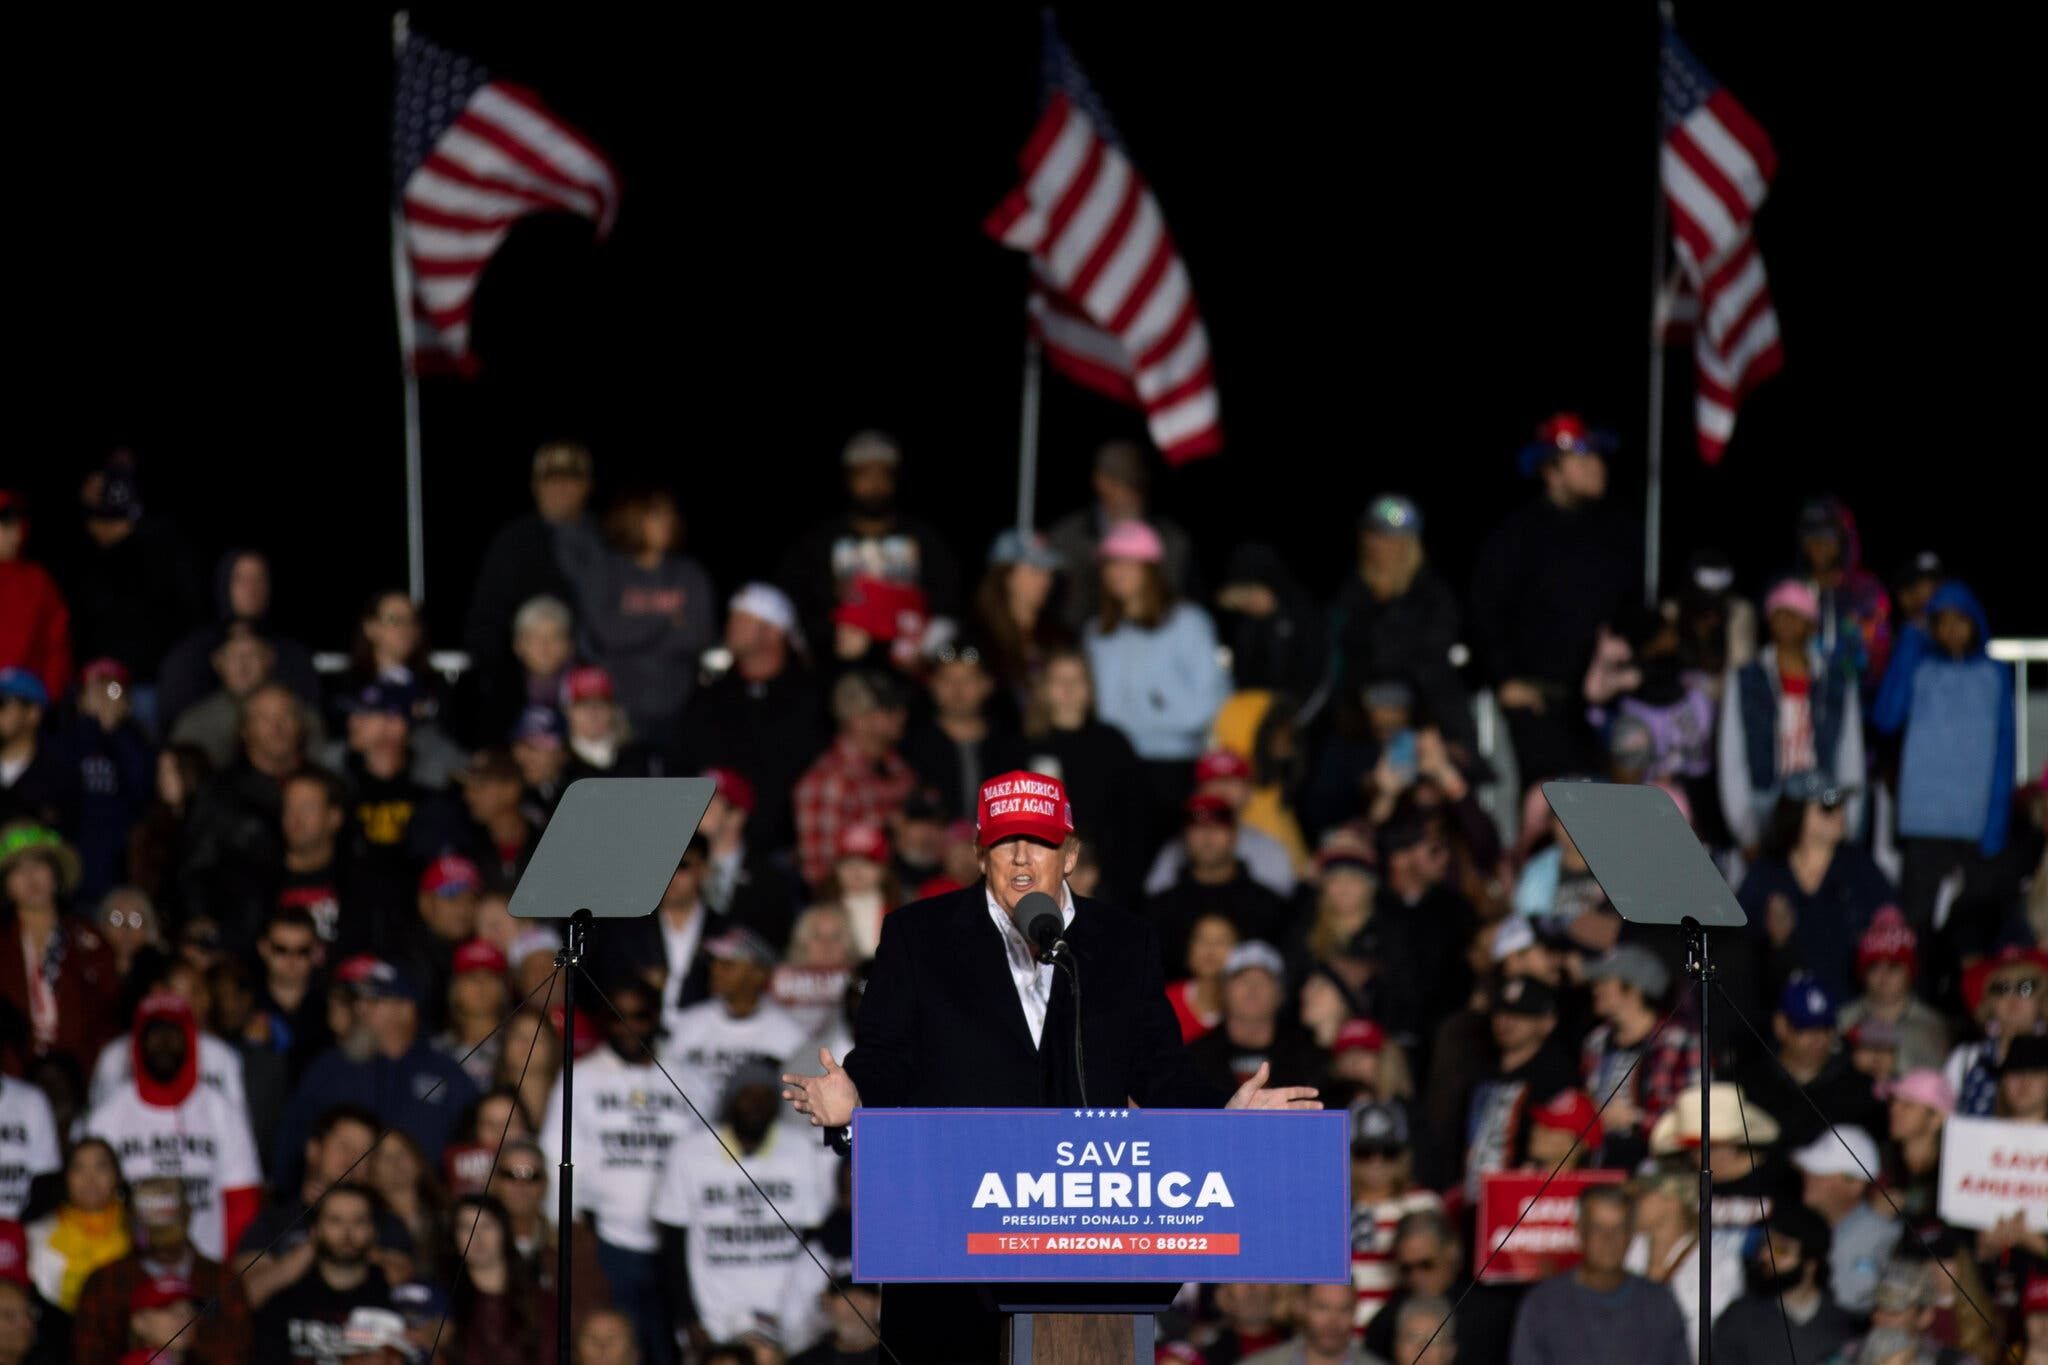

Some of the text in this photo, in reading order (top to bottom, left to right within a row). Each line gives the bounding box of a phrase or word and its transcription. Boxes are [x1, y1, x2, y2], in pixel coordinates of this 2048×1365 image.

[984, 779, 1060, 801] MAKE AMERICA
[990, 798, 1055, 817] GREAT AGAIN
[1055, 1141, 1151, 1167] SAVE
[971, 1171, 1235, 1209] AMERICA
[1002, 1214, 1205, 1226] PRESIDENT DONALD J. TRUMP
[998, 1237, 1208, 1250] TEXT ARIZONA TO 88022
